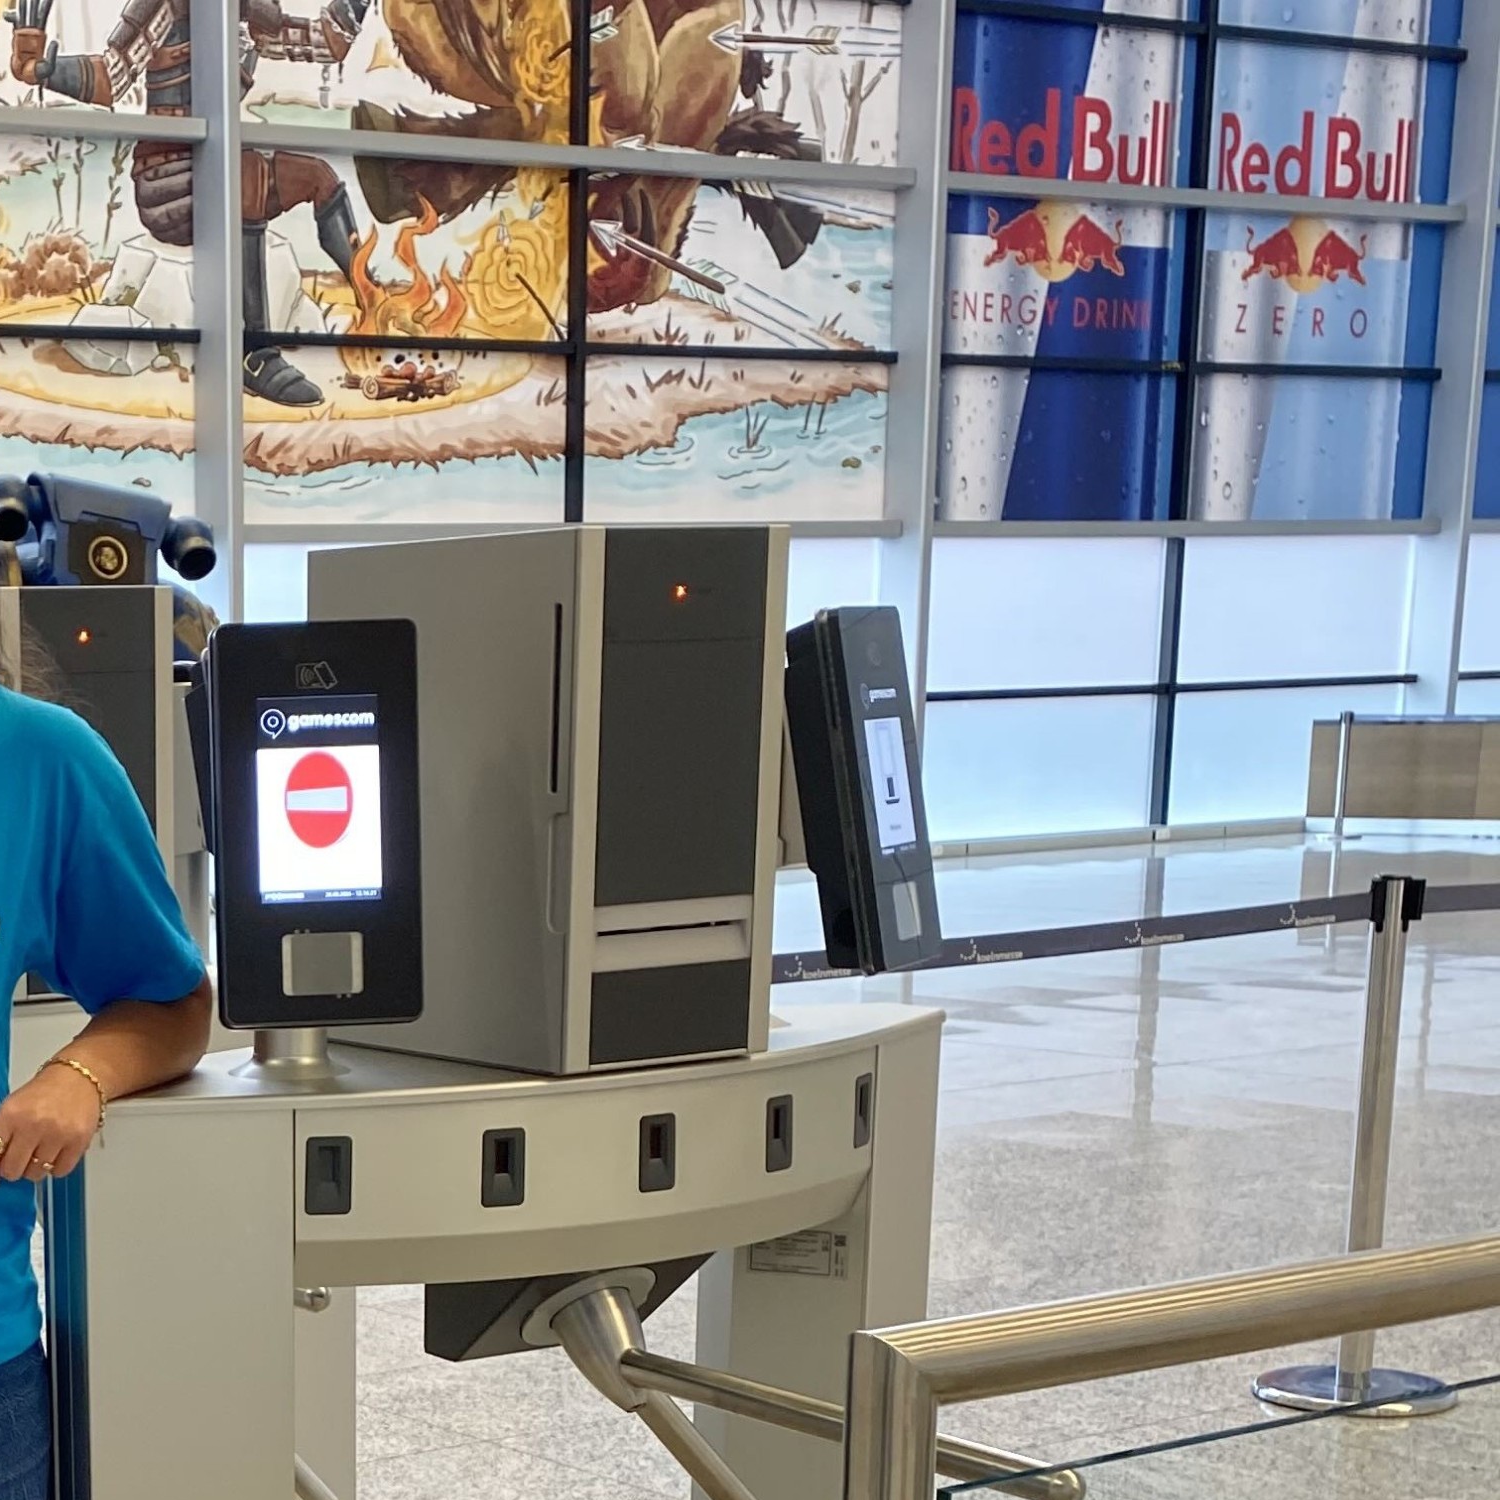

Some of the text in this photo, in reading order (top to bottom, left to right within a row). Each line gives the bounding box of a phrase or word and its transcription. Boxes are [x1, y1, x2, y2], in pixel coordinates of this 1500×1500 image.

[952, 87, 1171, 188] Red Bull
[1218, 110, 1414, 204] Red Bull
[950, 289, 1060, 326] ENERGY
[287, 712, 375, 732] gamescom
